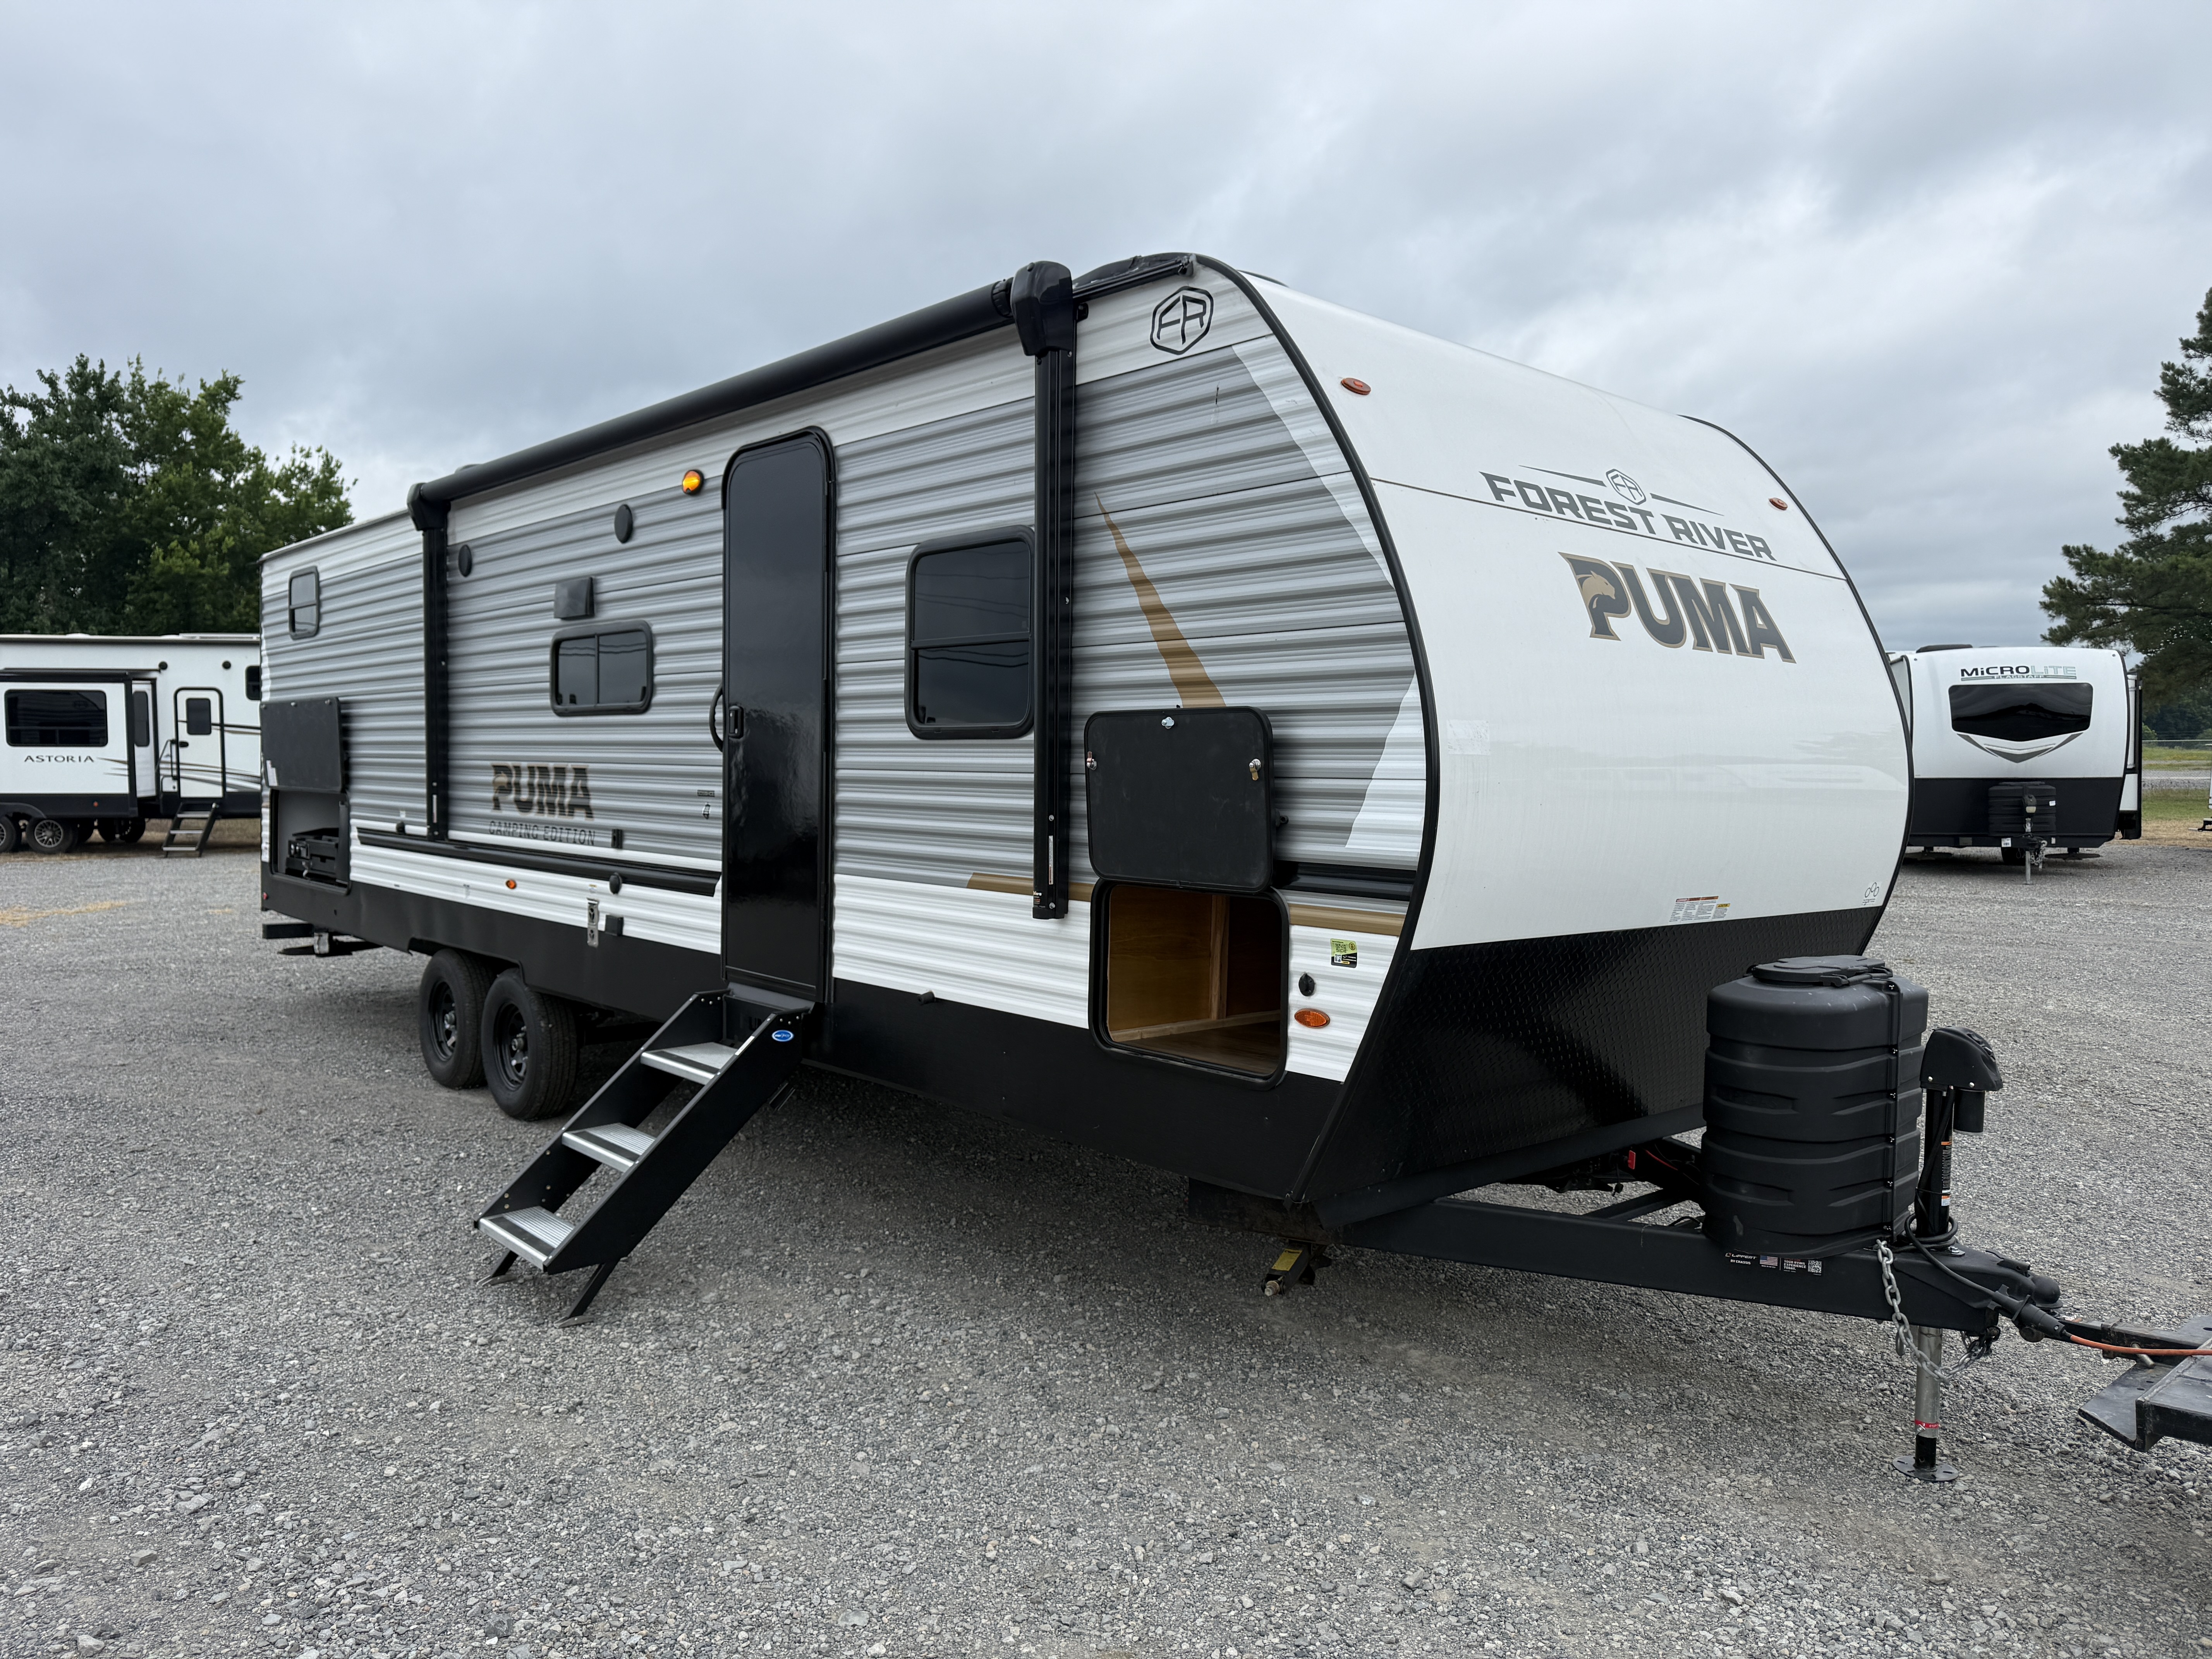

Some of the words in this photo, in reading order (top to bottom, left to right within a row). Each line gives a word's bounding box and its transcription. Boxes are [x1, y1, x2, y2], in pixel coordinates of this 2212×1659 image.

[1479, 471, 1656, 535] FOREST
[1660, 514, 1777, 562] RIVER
[1558, 552, 1797, 664] PUMA
[24, 755, 94, 763] ASTORIA
[490, 763, 594, 821] PUMA
[488, 821, 539, 840] CAMPING
[543, 826, 596, 847] EDITION
